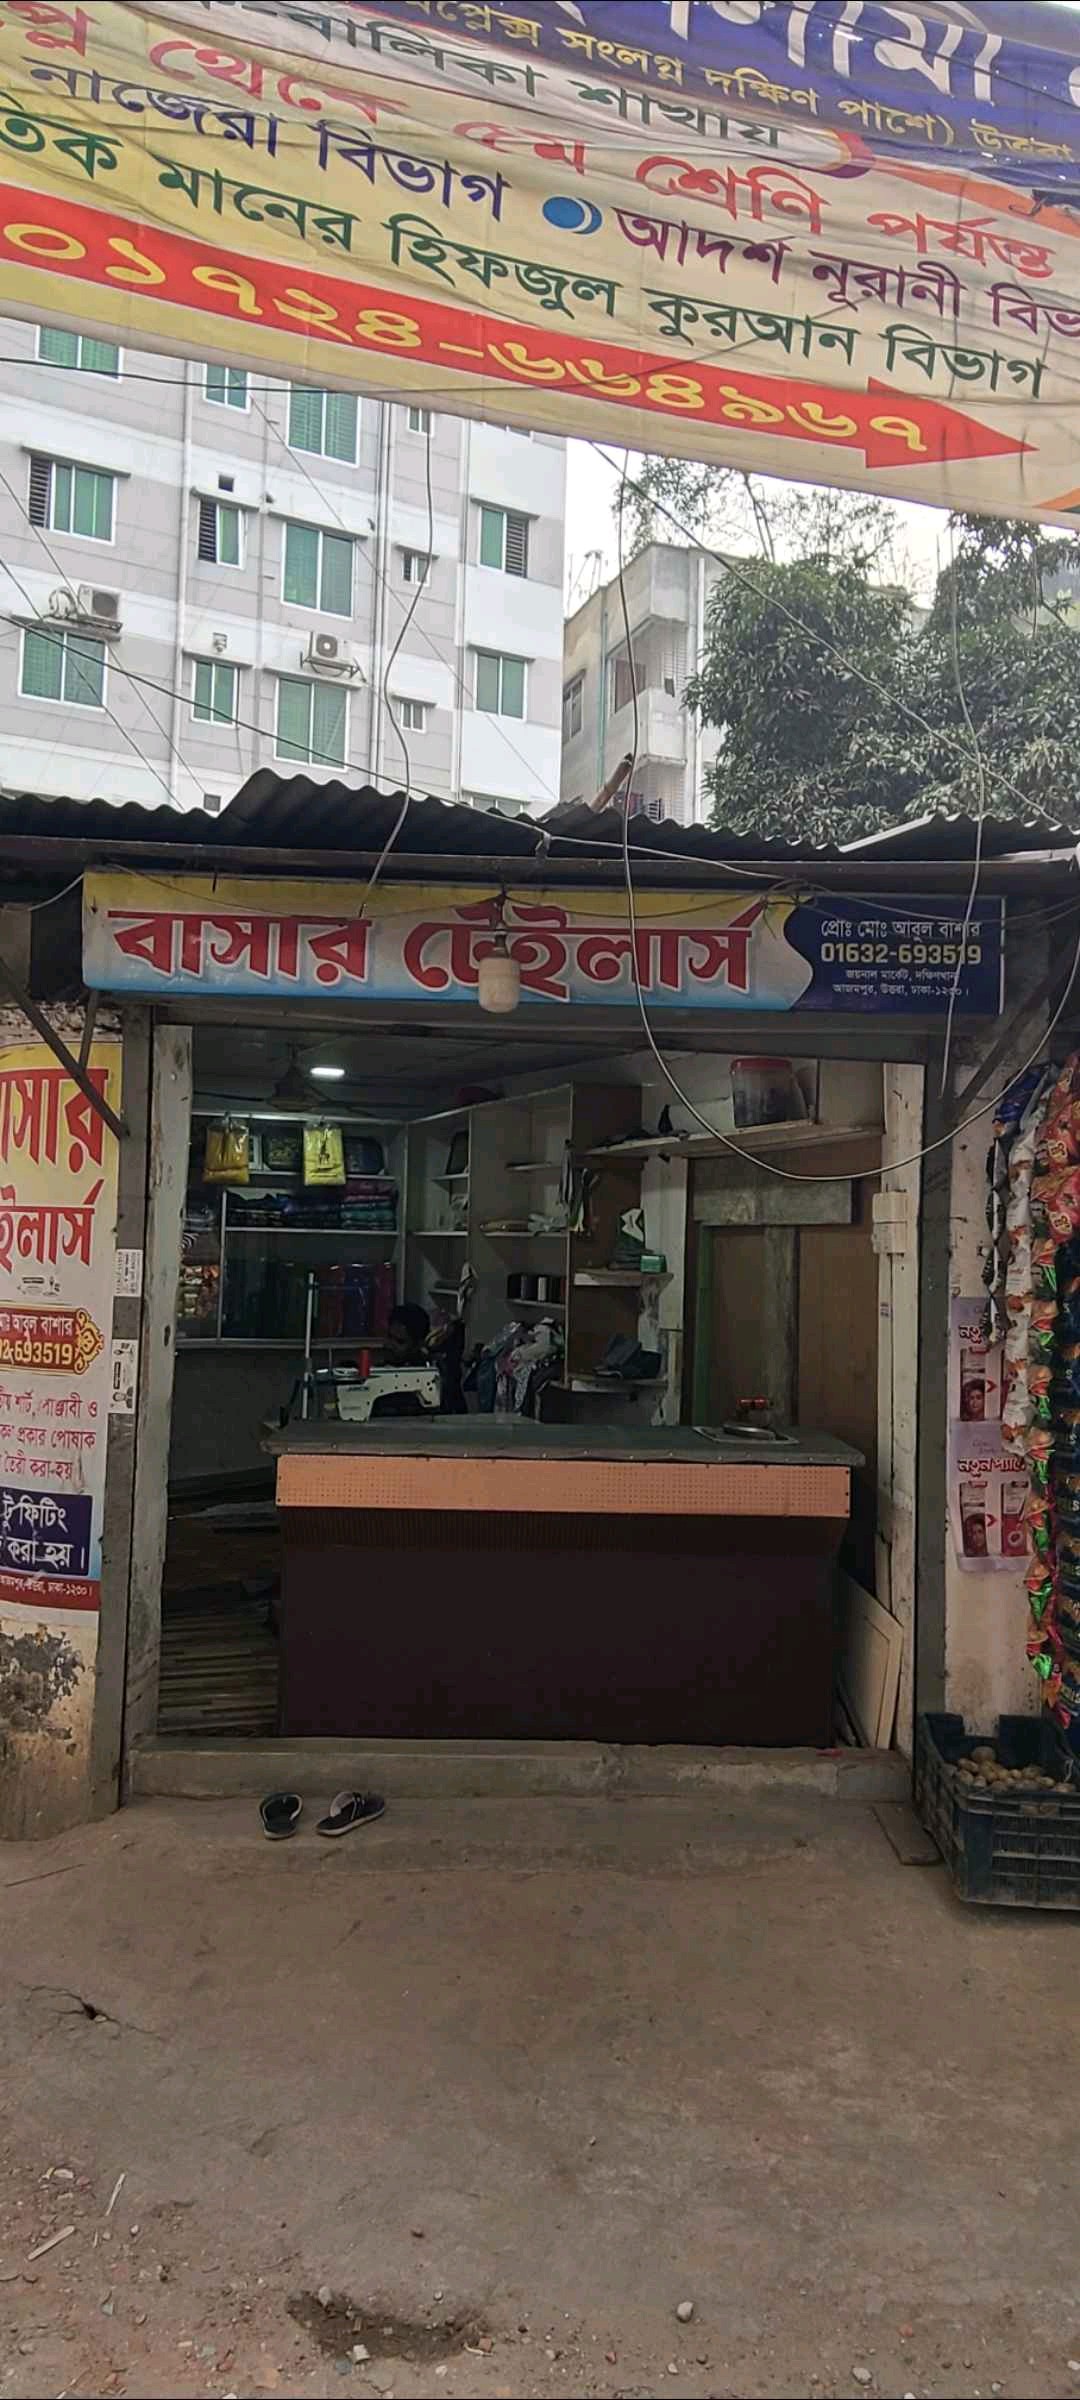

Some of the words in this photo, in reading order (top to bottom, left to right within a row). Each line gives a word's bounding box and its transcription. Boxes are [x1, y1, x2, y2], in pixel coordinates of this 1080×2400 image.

[692, 67, 819, 116] দক্ষিণ
[20, 55, 288, 157] নাজেরা
[306, 118, 513, 222] বিভাগ
[154, 153, 362, 252] মানের
[381, 213, 624, 319] হিফজুল
[641, 286, 862, 366] কুরআন
[877, 324, 1051, 398] বিভাগ
[611, 206, 797, 284] আদর্শ
[807, 250, 969, 318] নূরানী
[866, 213, 1055, 278] পর্যন্ত
[3, 223, 927, 452] ০১৭২৪-৬৬৪৯৬৭
[108, 910, 372, 984] বাসার
[404, 902, 767, 1000] টেইলার্স
[820, 942, 982, 965] 01632-693519
[857, 920, 888, 937] মোঃ
[892, 920, 934, 943] আবুল
[939, 921, 982, 939] বাশার
[19, 1494, 68, 1533] ফিটিং
